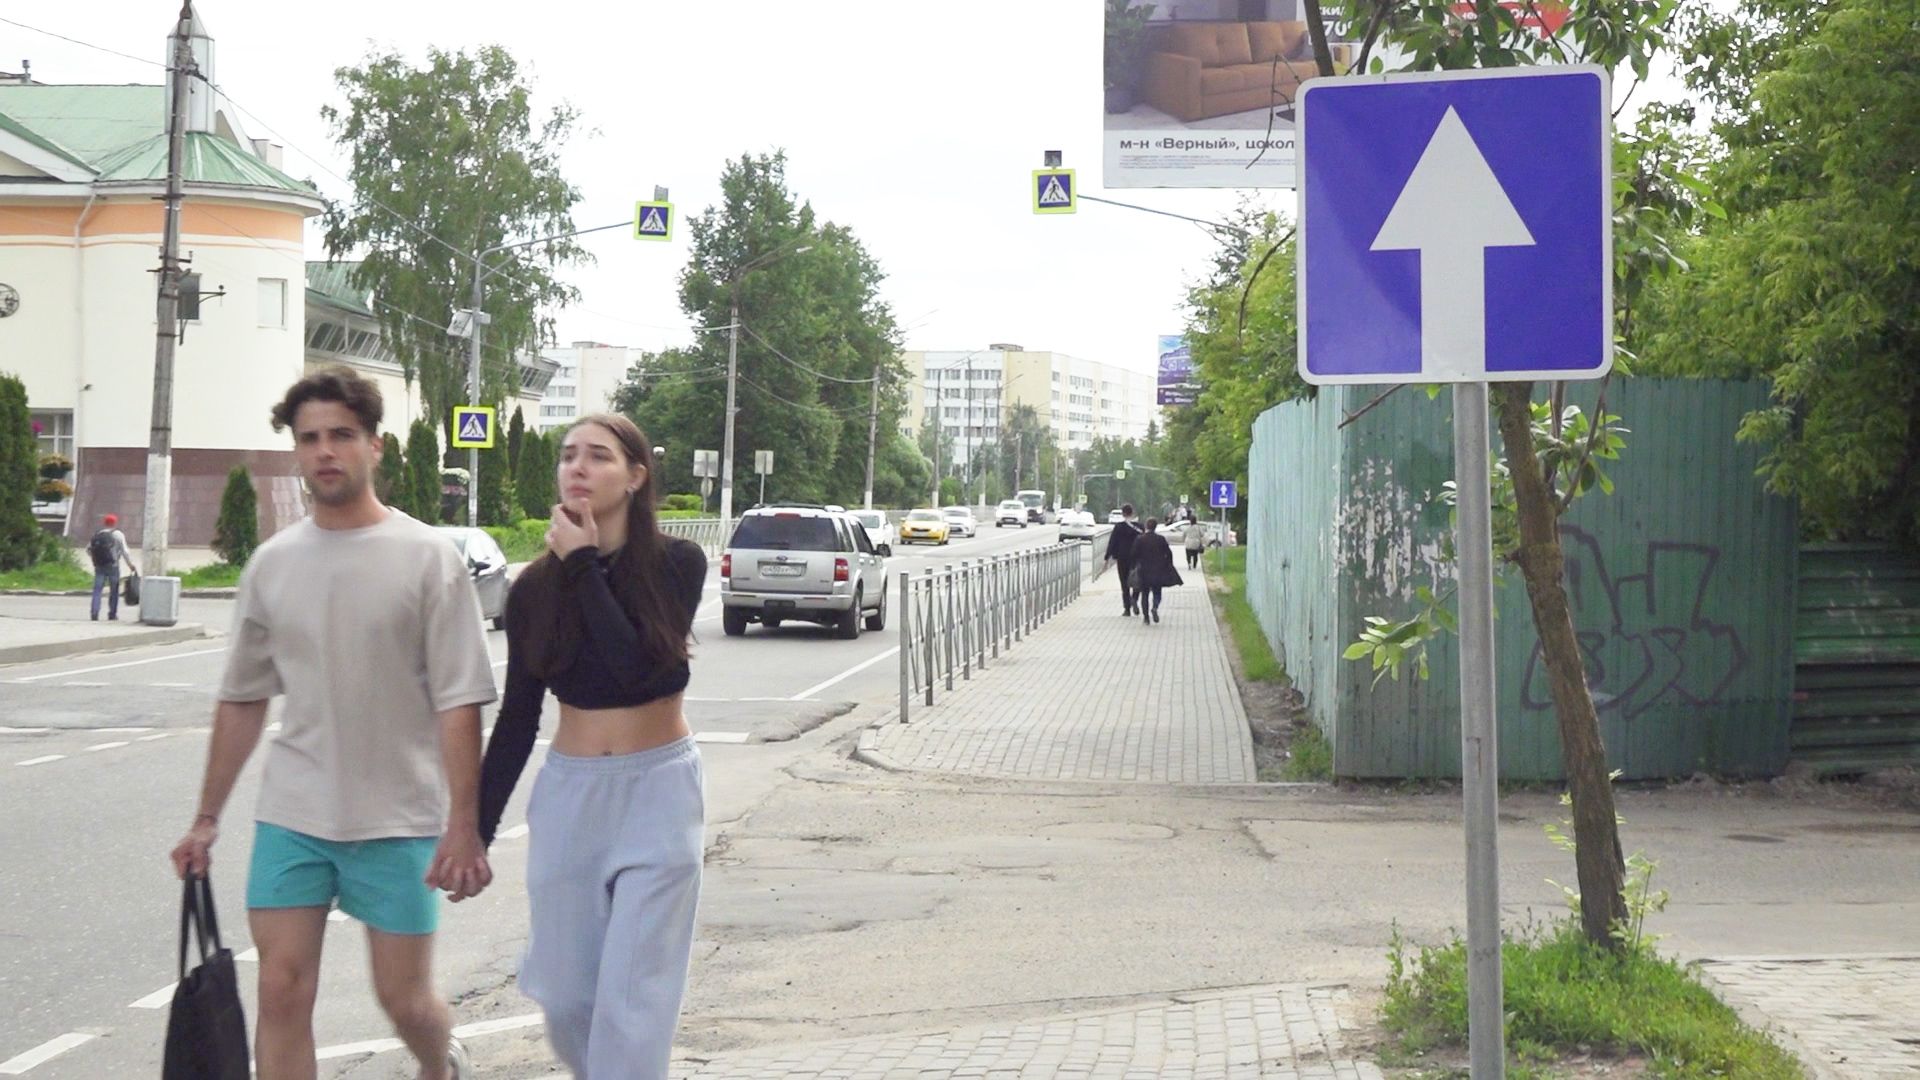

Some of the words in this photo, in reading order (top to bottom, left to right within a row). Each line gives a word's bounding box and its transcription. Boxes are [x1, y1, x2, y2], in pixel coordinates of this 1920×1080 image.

[1322, 21, 1353, 36] 70
[1120, 139, 1150, 149] м-н
[1155, 137, 1240, 151] «Верный»,
